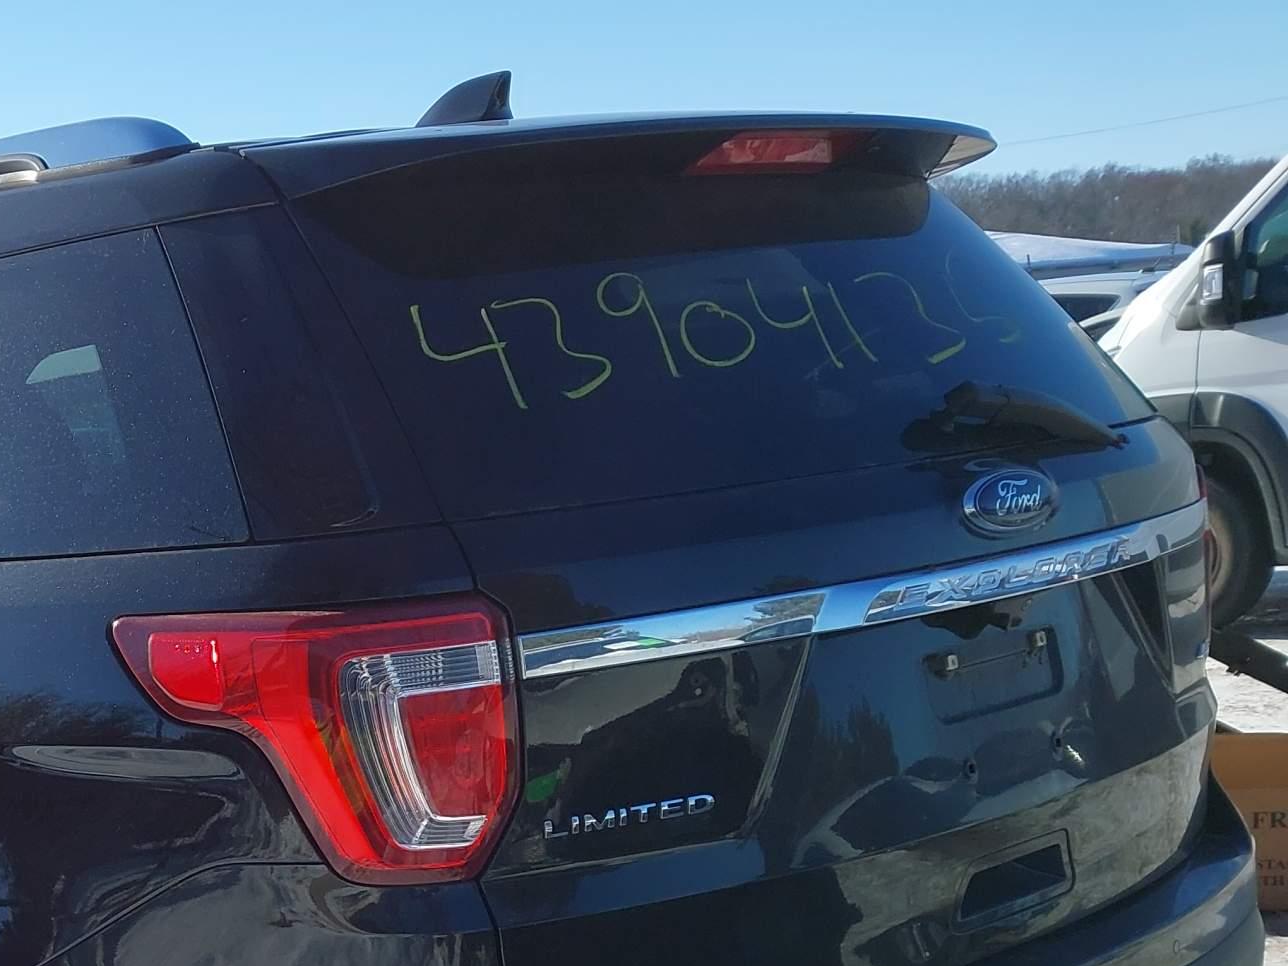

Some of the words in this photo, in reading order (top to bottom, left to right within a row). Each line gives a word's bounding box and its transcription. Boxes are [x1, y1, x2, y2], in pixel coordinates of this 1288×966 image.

[996, 479, 1041, 516] Ford
[894, 535, 1131, 611] EXPLORER
[543, 794, 716, 839] LIMITED
